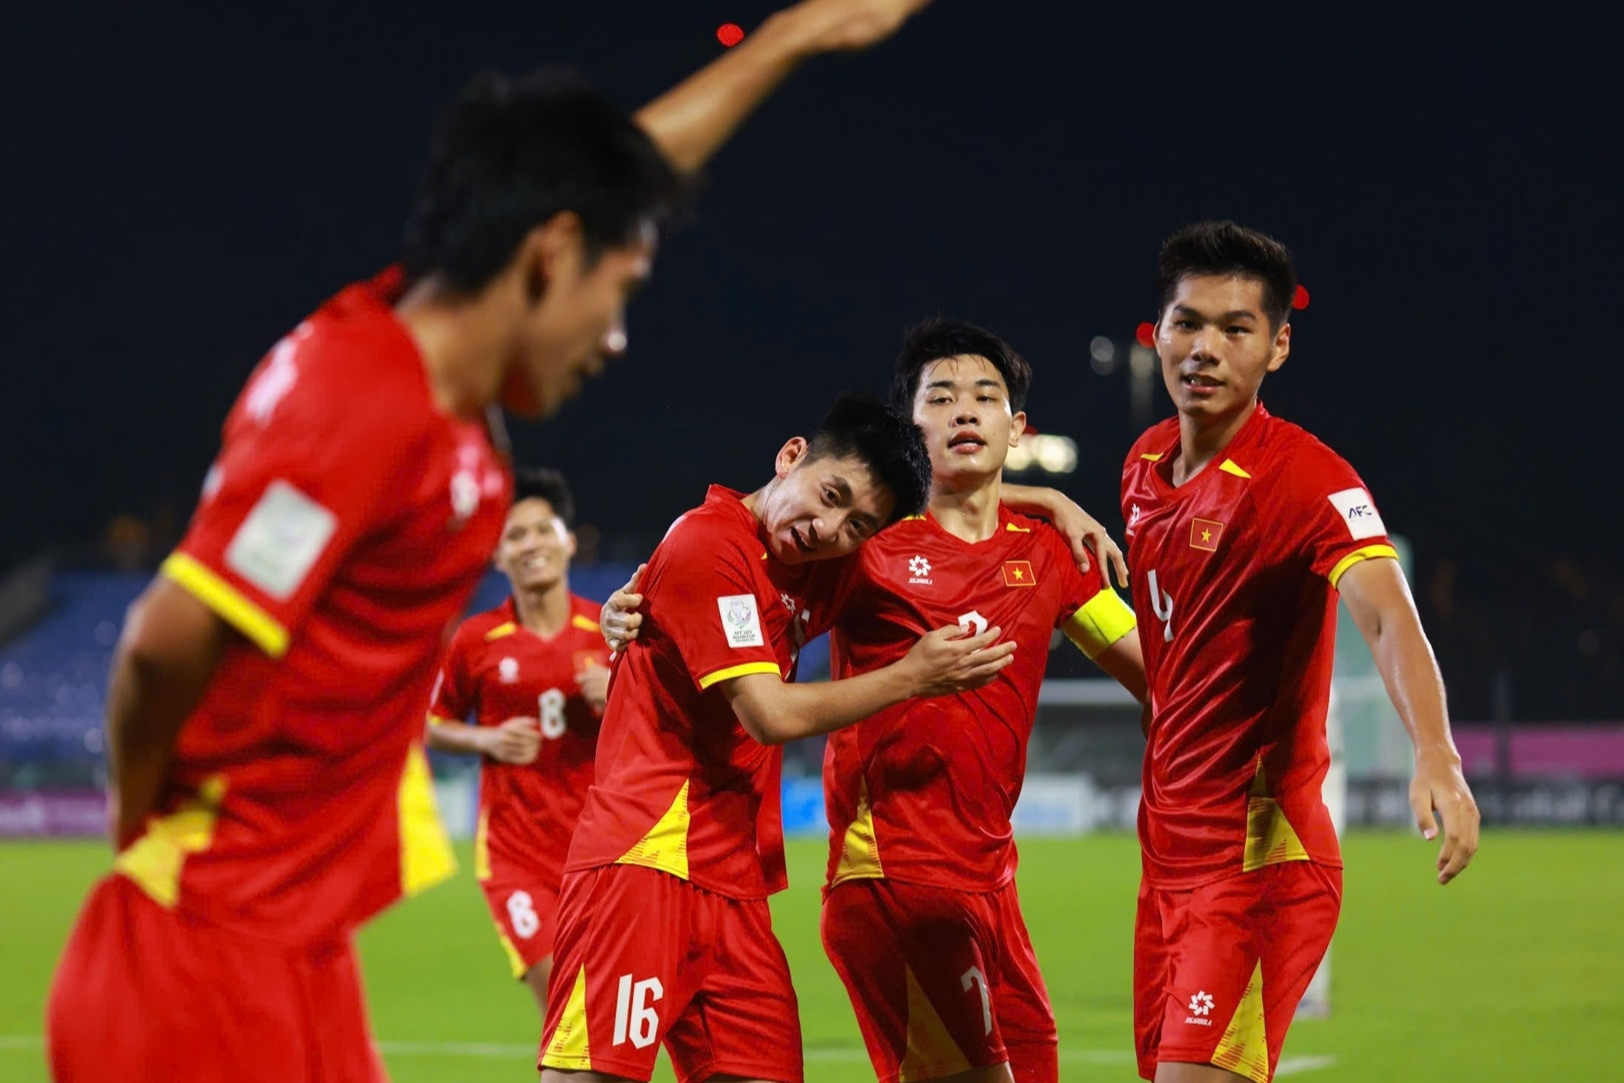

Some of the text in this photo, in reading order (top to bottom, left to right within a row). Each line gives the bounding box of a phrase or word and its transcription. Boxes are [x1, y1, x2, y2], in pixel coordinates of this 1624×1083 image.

[1349, 504, 1372, 519] AFC
[1147, 569, 1174, 643] 4
[538, 687, 565, 739] 8
[506, 890, 540, 939] 8
[612, 973, 664, 1049] 16
[960, 965, 992, 1037] 7
